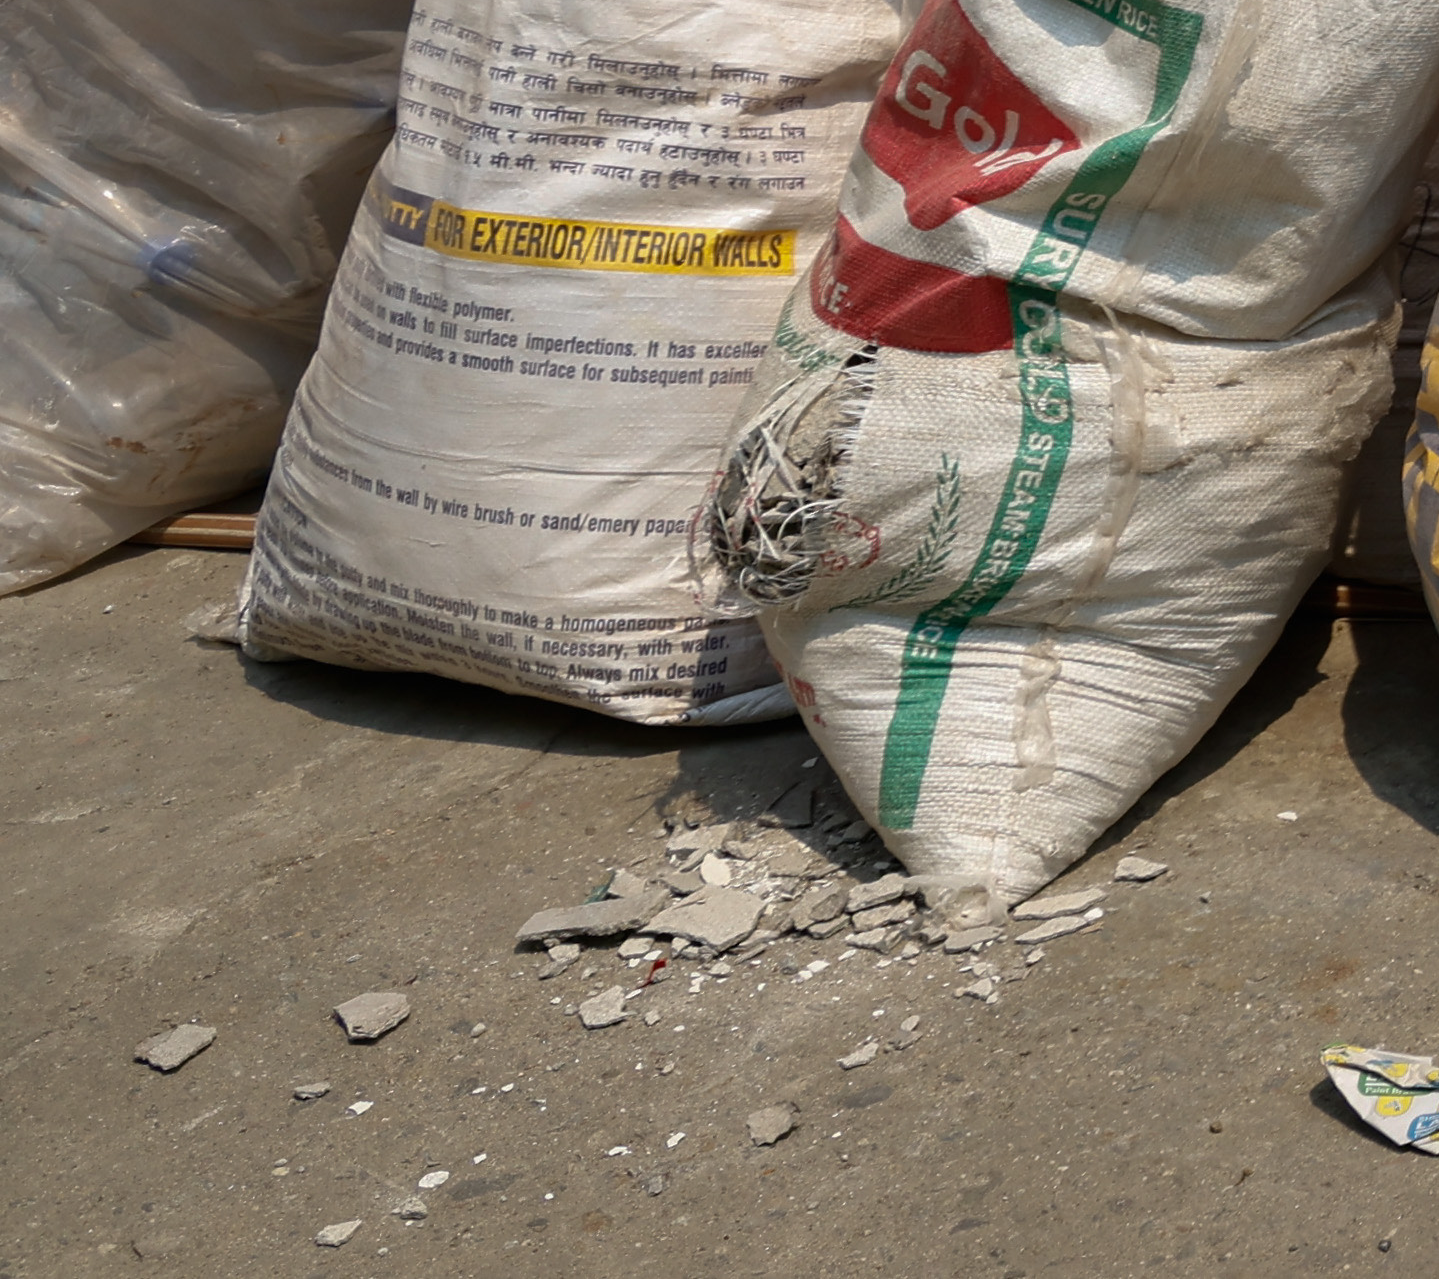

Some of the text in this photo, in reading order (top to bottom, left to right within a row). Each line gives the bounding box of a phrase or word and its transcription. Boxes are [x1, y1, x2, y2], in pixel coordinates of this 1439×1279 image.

[1117, 1, 1159, 38] RICE
[433, 211, 783, 270] FOR EXTERIOR/INTERIOR WALLS
[453, 299, 515, 326] polymer.
[424, 317, 435, 336] to
[464, 325, 518, 350] surface
[526, 331, 638, 359] imperfections.
[667, 339, 697, 359] has
[461, 353, 515, 374] smooth
[520, 359, 576, 380] surface
[582, 365, 605, 382] for
[610, 366, 704, 388] subsequent
[396, 486, 420, 509] wall
[422, 493, 438, 516] by
[441, 497, 469, 519] wire
[473, 502, 515, 528] brush
[519, 511, 536, 528] or
[540, 513, 641, 537] sand/emery
[501, 606, 538, 629] make
[559, 613, 677, 636] homogeneous
[542, 636, 629, 661] necessary,
[637, 637, 673, 656] with
[567, 657, 728, 683] Always mix desired
